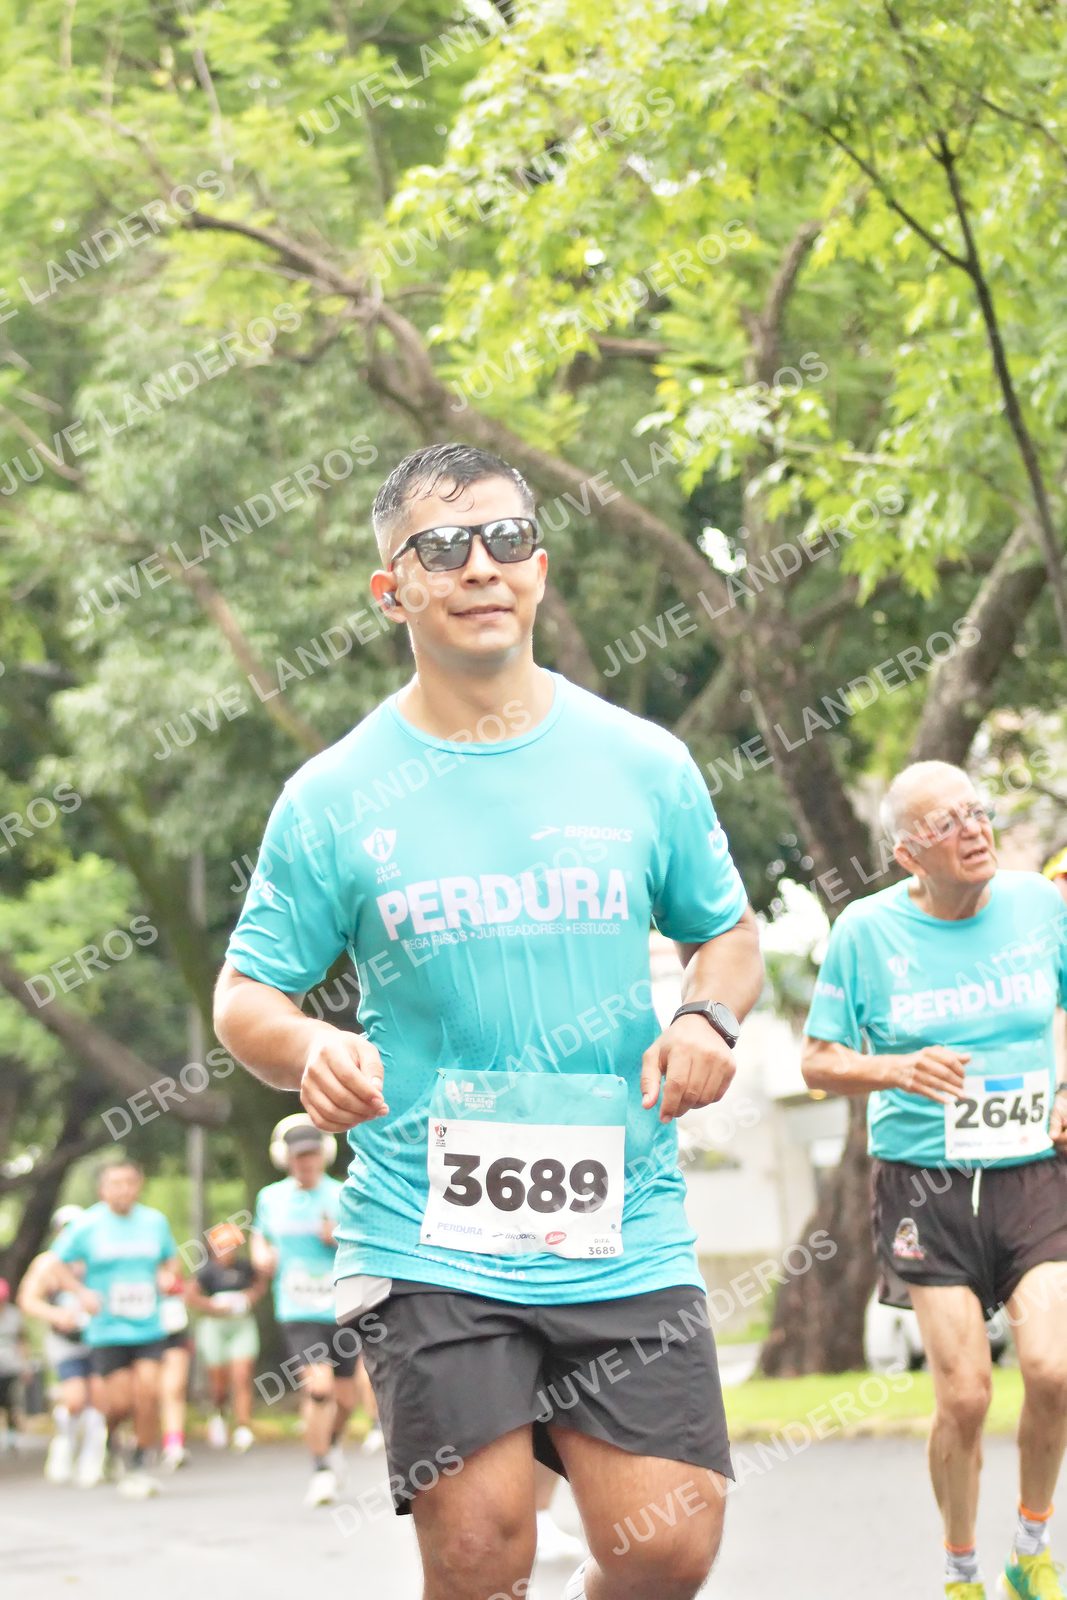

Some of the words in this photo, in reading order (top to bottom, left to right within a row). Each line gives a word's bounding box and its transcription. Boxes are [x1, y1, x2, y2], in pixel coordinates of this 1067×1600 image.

[565, 826, 633, 842] BROOKS
[377, 870, 401, 885] ATLAS
[376, 866, 629, 941] PERDURA
[476, 923, 564, 940] JUNTEADORES
[571, 923, 621, 936] ESTUCOS
[890, 969, 1052, 1024] PERDURA
[954, 1092, 1045, 1129] 2645
[443, 1153, 609, 1214] 3689
[437, 1222, 483, 1236] PERDURA
[504, 1232, 537, 1241] BROOKS
[588, 1246, 616, 1256] 3689
